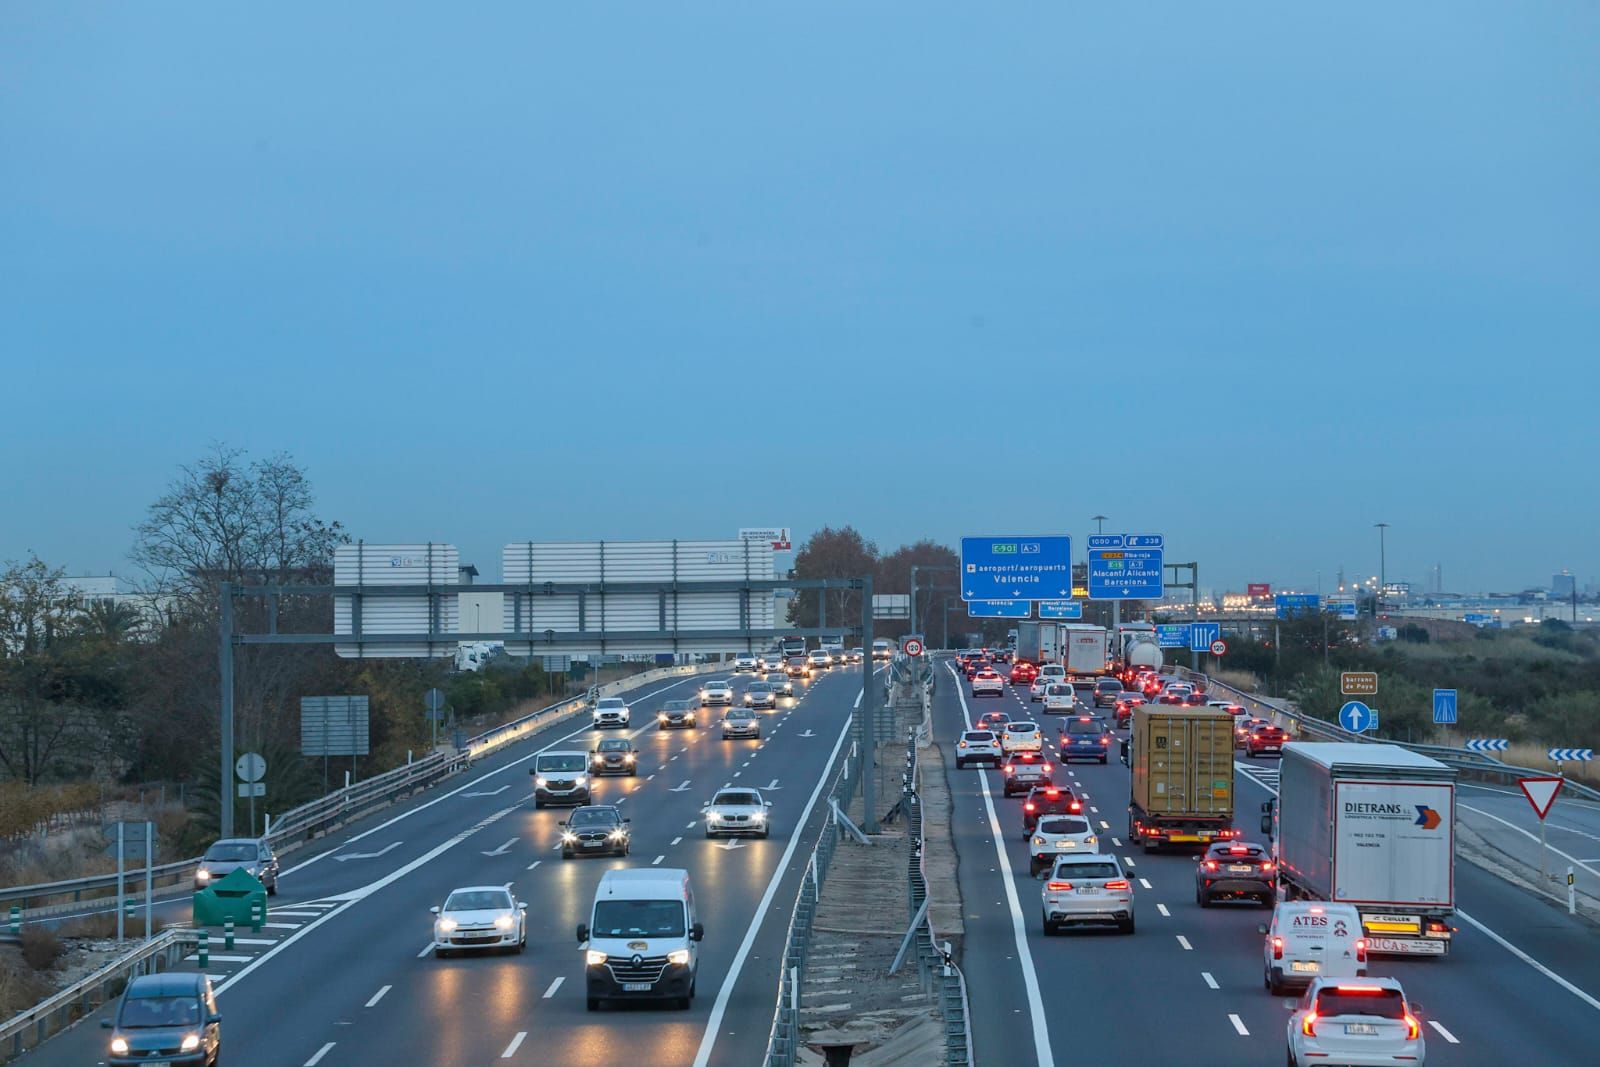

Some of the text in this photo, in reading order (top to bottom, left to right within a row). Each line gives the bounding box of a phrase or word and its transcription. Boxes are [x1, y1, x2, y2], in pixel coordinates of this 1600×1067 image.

[994, 575, 1040, 583] Valencia
[1104, 578, 1147, 586] Barcelona
[908, 644, 919, 652] 120
[1213, 644, 1224, 652] 120
[1345, 802, 1401, 814] DIETRANS
[1293, 916, 1328, 926] ATES
